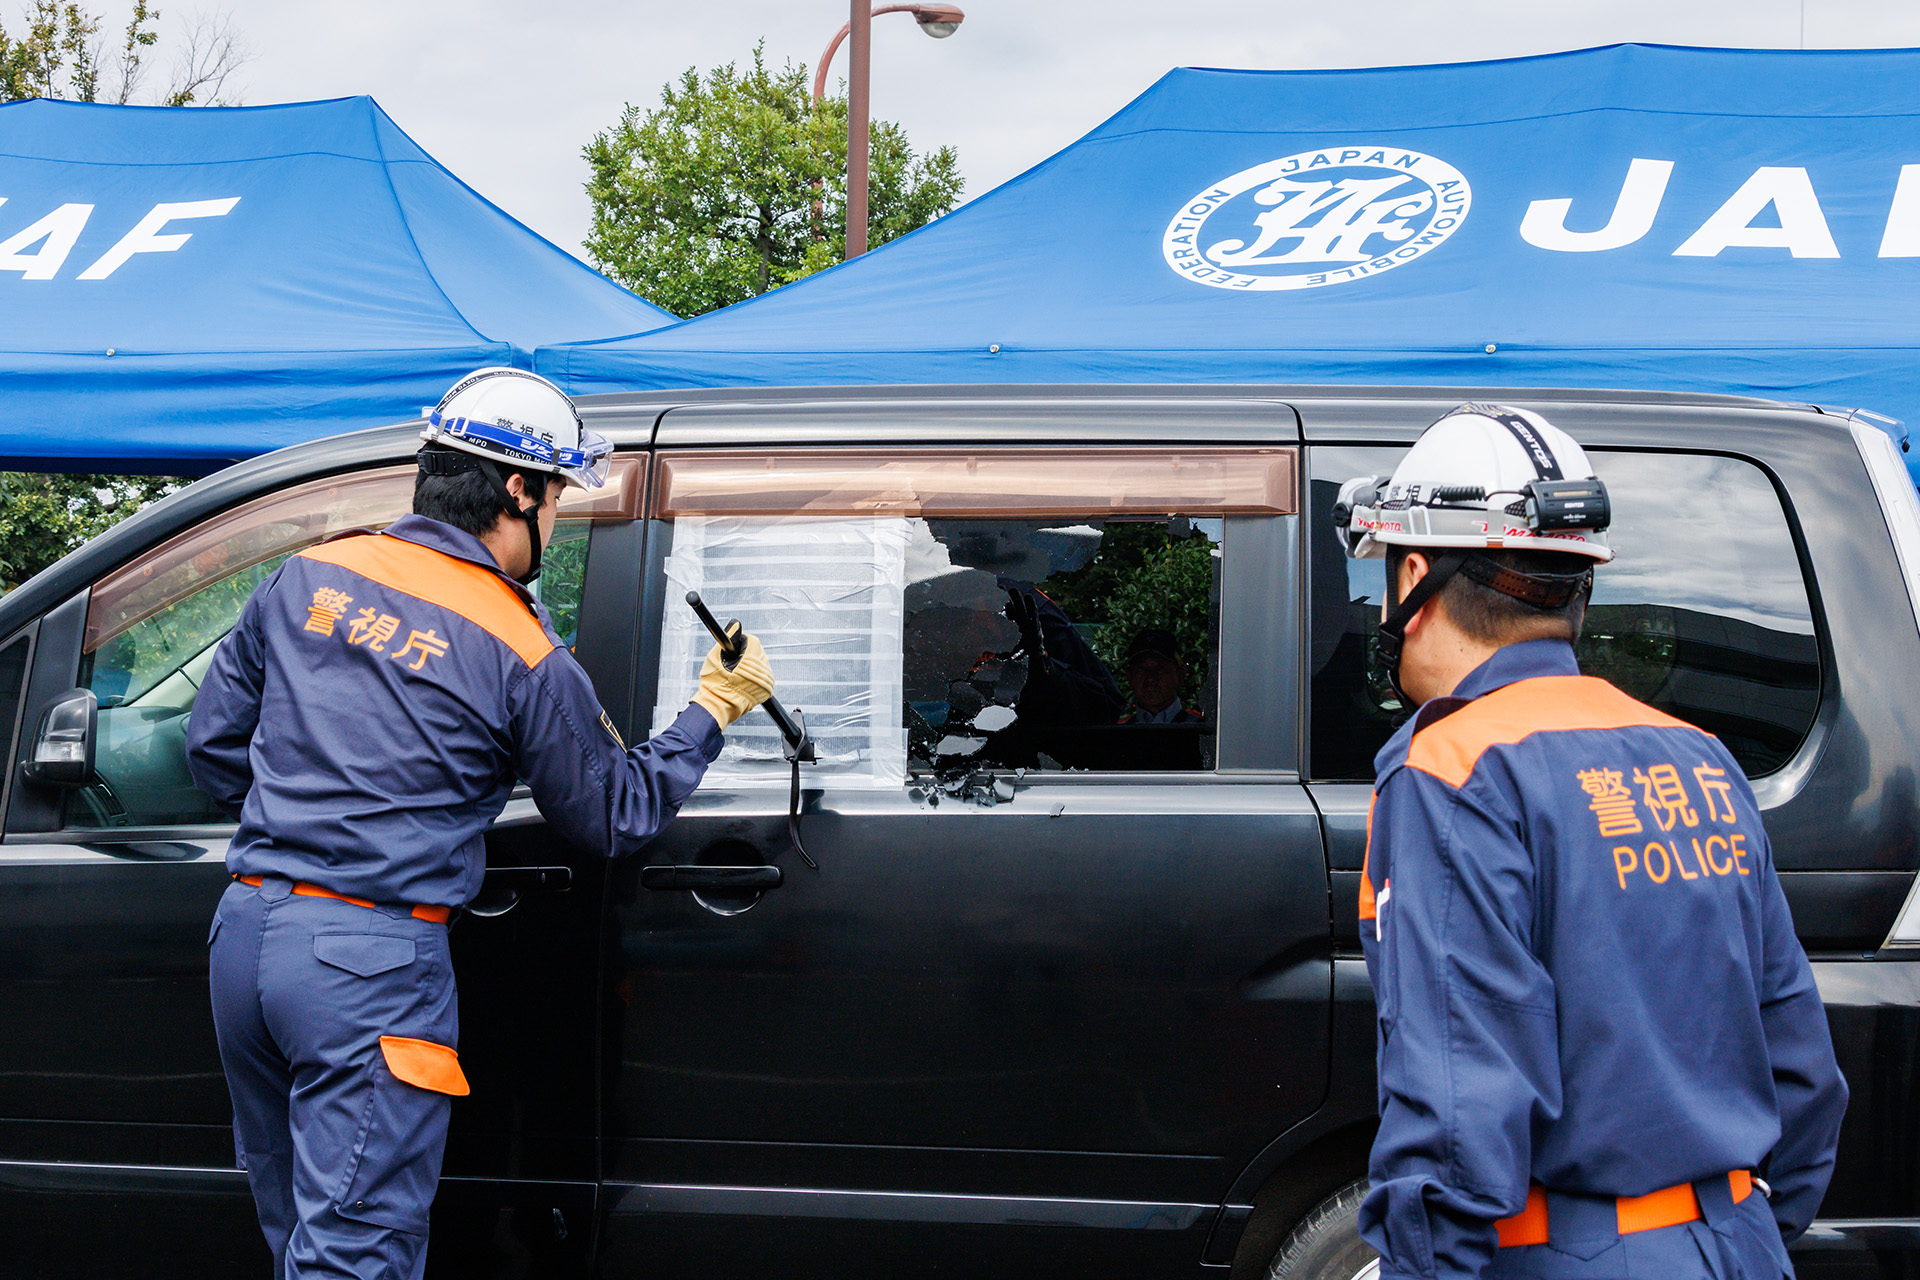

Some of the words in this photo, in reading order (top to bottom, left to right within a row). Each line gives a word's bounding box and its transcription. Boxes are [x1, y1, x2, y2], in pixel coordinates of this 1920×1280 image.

[1281, 150, 1421, 173] JAPAN
[0, 196, 242, 280] AF
[1171, 189, 1258, 288] FEDERATION
[1306, 179, 1465, 287] AUTOMOBILE
[468, 437, 488, 448] MPD
[504, 448, 532, 461] TOKYO
[1510, 420, 1554, 469] GENTOS
[304, 586, 450, 671] 警視庁
[1576, 761, 1737, 838] 警視庁
[1612, 834, 1750, 890] POLICE
